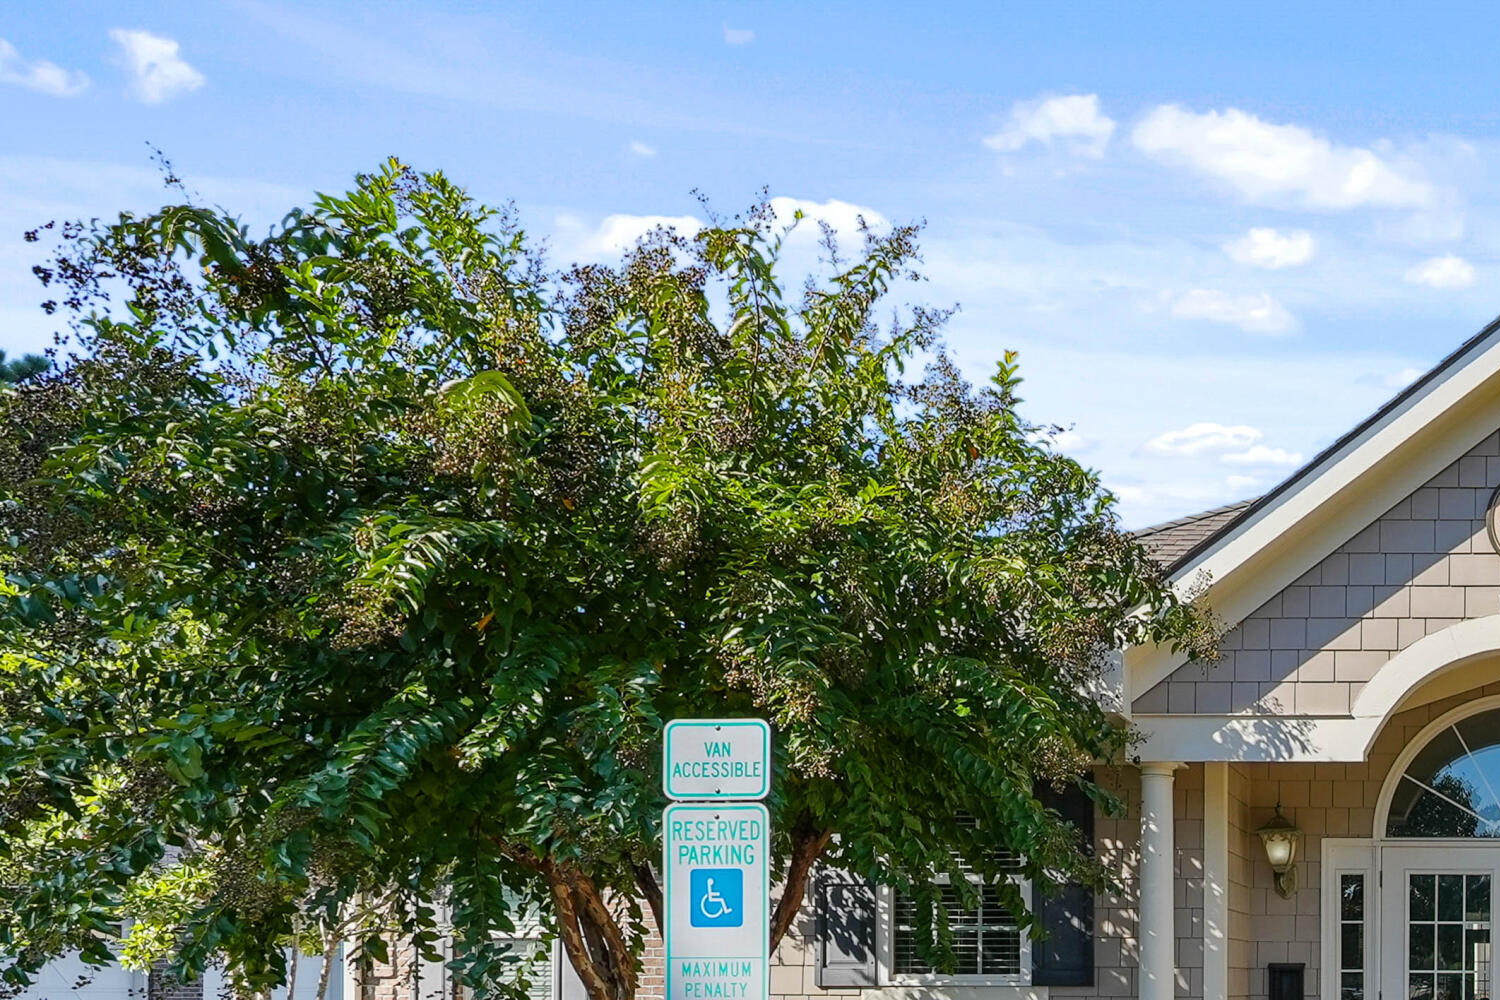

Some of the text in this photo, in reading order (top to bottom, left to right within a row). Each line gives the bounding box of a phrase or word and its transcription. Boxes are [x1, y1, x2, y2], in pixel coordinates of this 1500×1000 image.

[704, 742, 731, 758] VAN
[673, 762, 761, 778] ACCESSIBLE
[673, 820, 760, 841] RESERVED
[679, 844, 755, 865] PARKING
[682, 961, 751, 977] MAXIMUM
[685, 982, 747, 998] PENALTY
